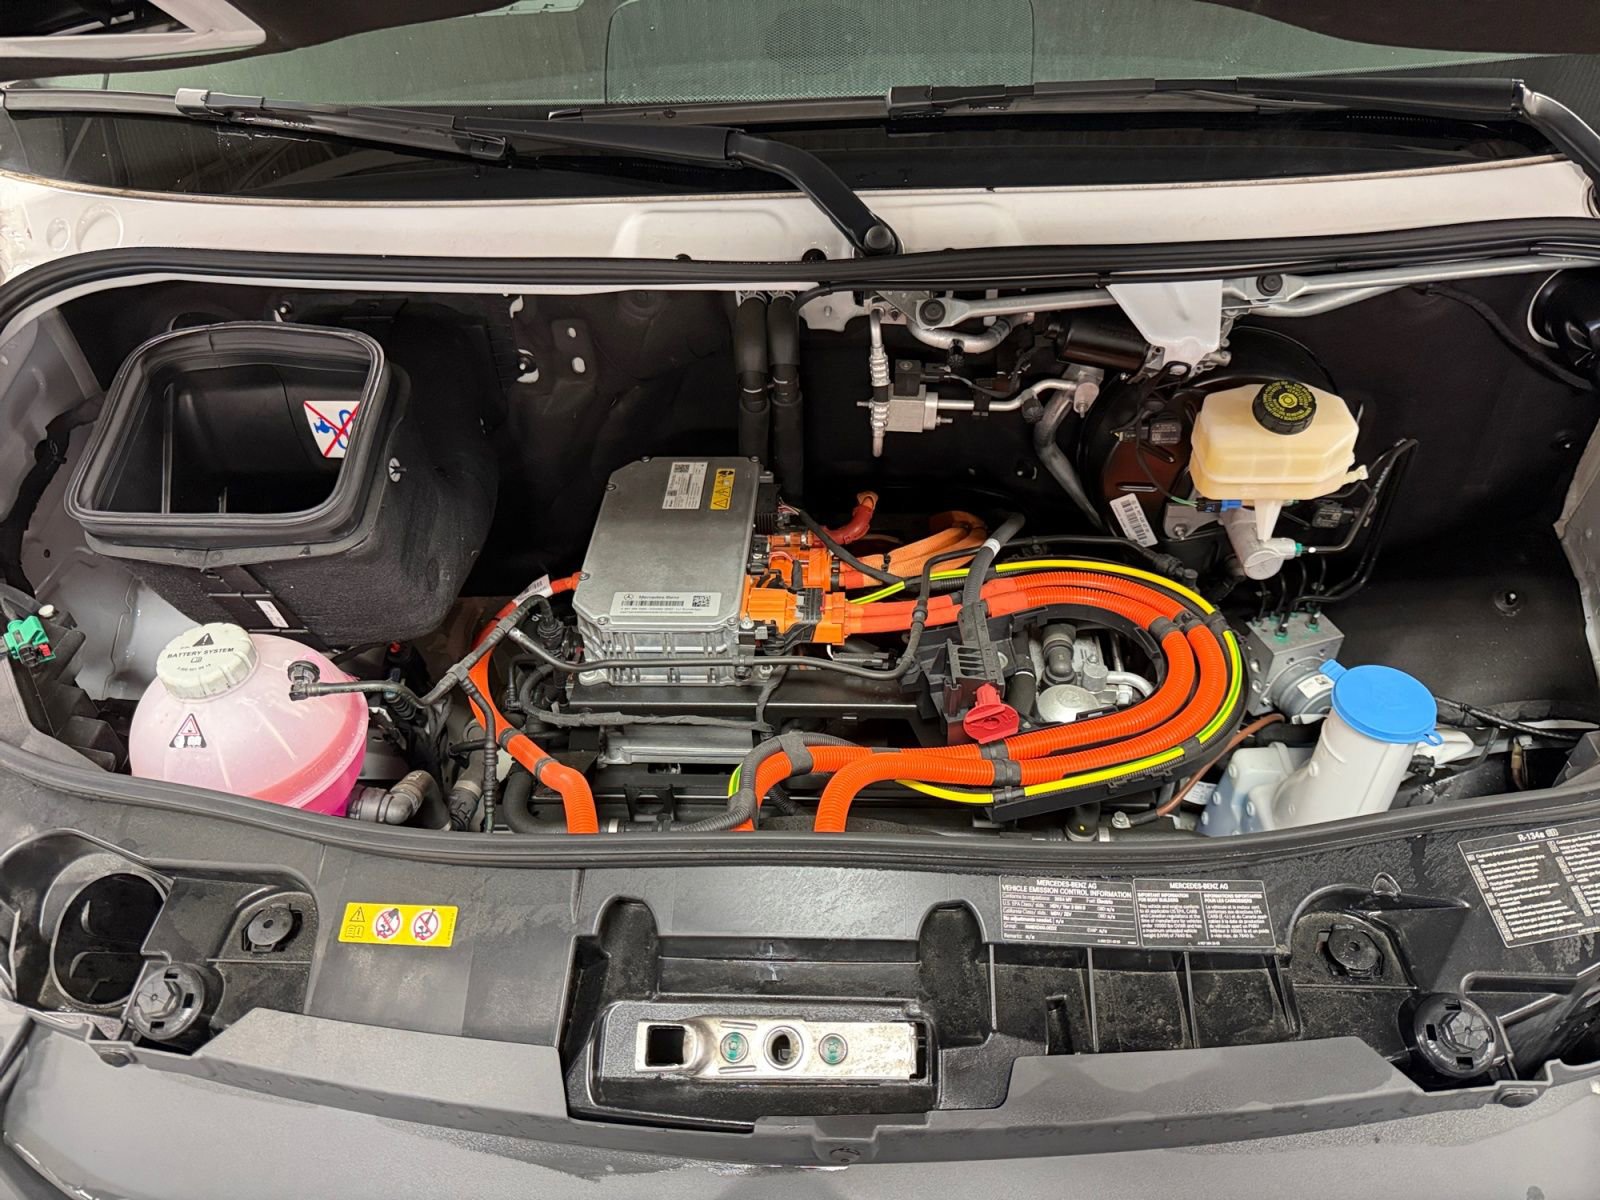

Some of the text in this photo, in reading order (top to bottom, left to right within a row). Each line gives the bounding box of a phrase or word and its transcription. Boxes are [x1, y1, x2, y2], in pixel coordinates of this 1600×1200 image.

[167, 650, 202, 658] BATTERY
[1517, 832, 1546, 842] R-134a
[1036, 880, 1086, 889] MERCEDES-BENZ
[1060, 888, 1088, 896] CONTROL
[1090, 890, 1132, 898] INFORMATION
